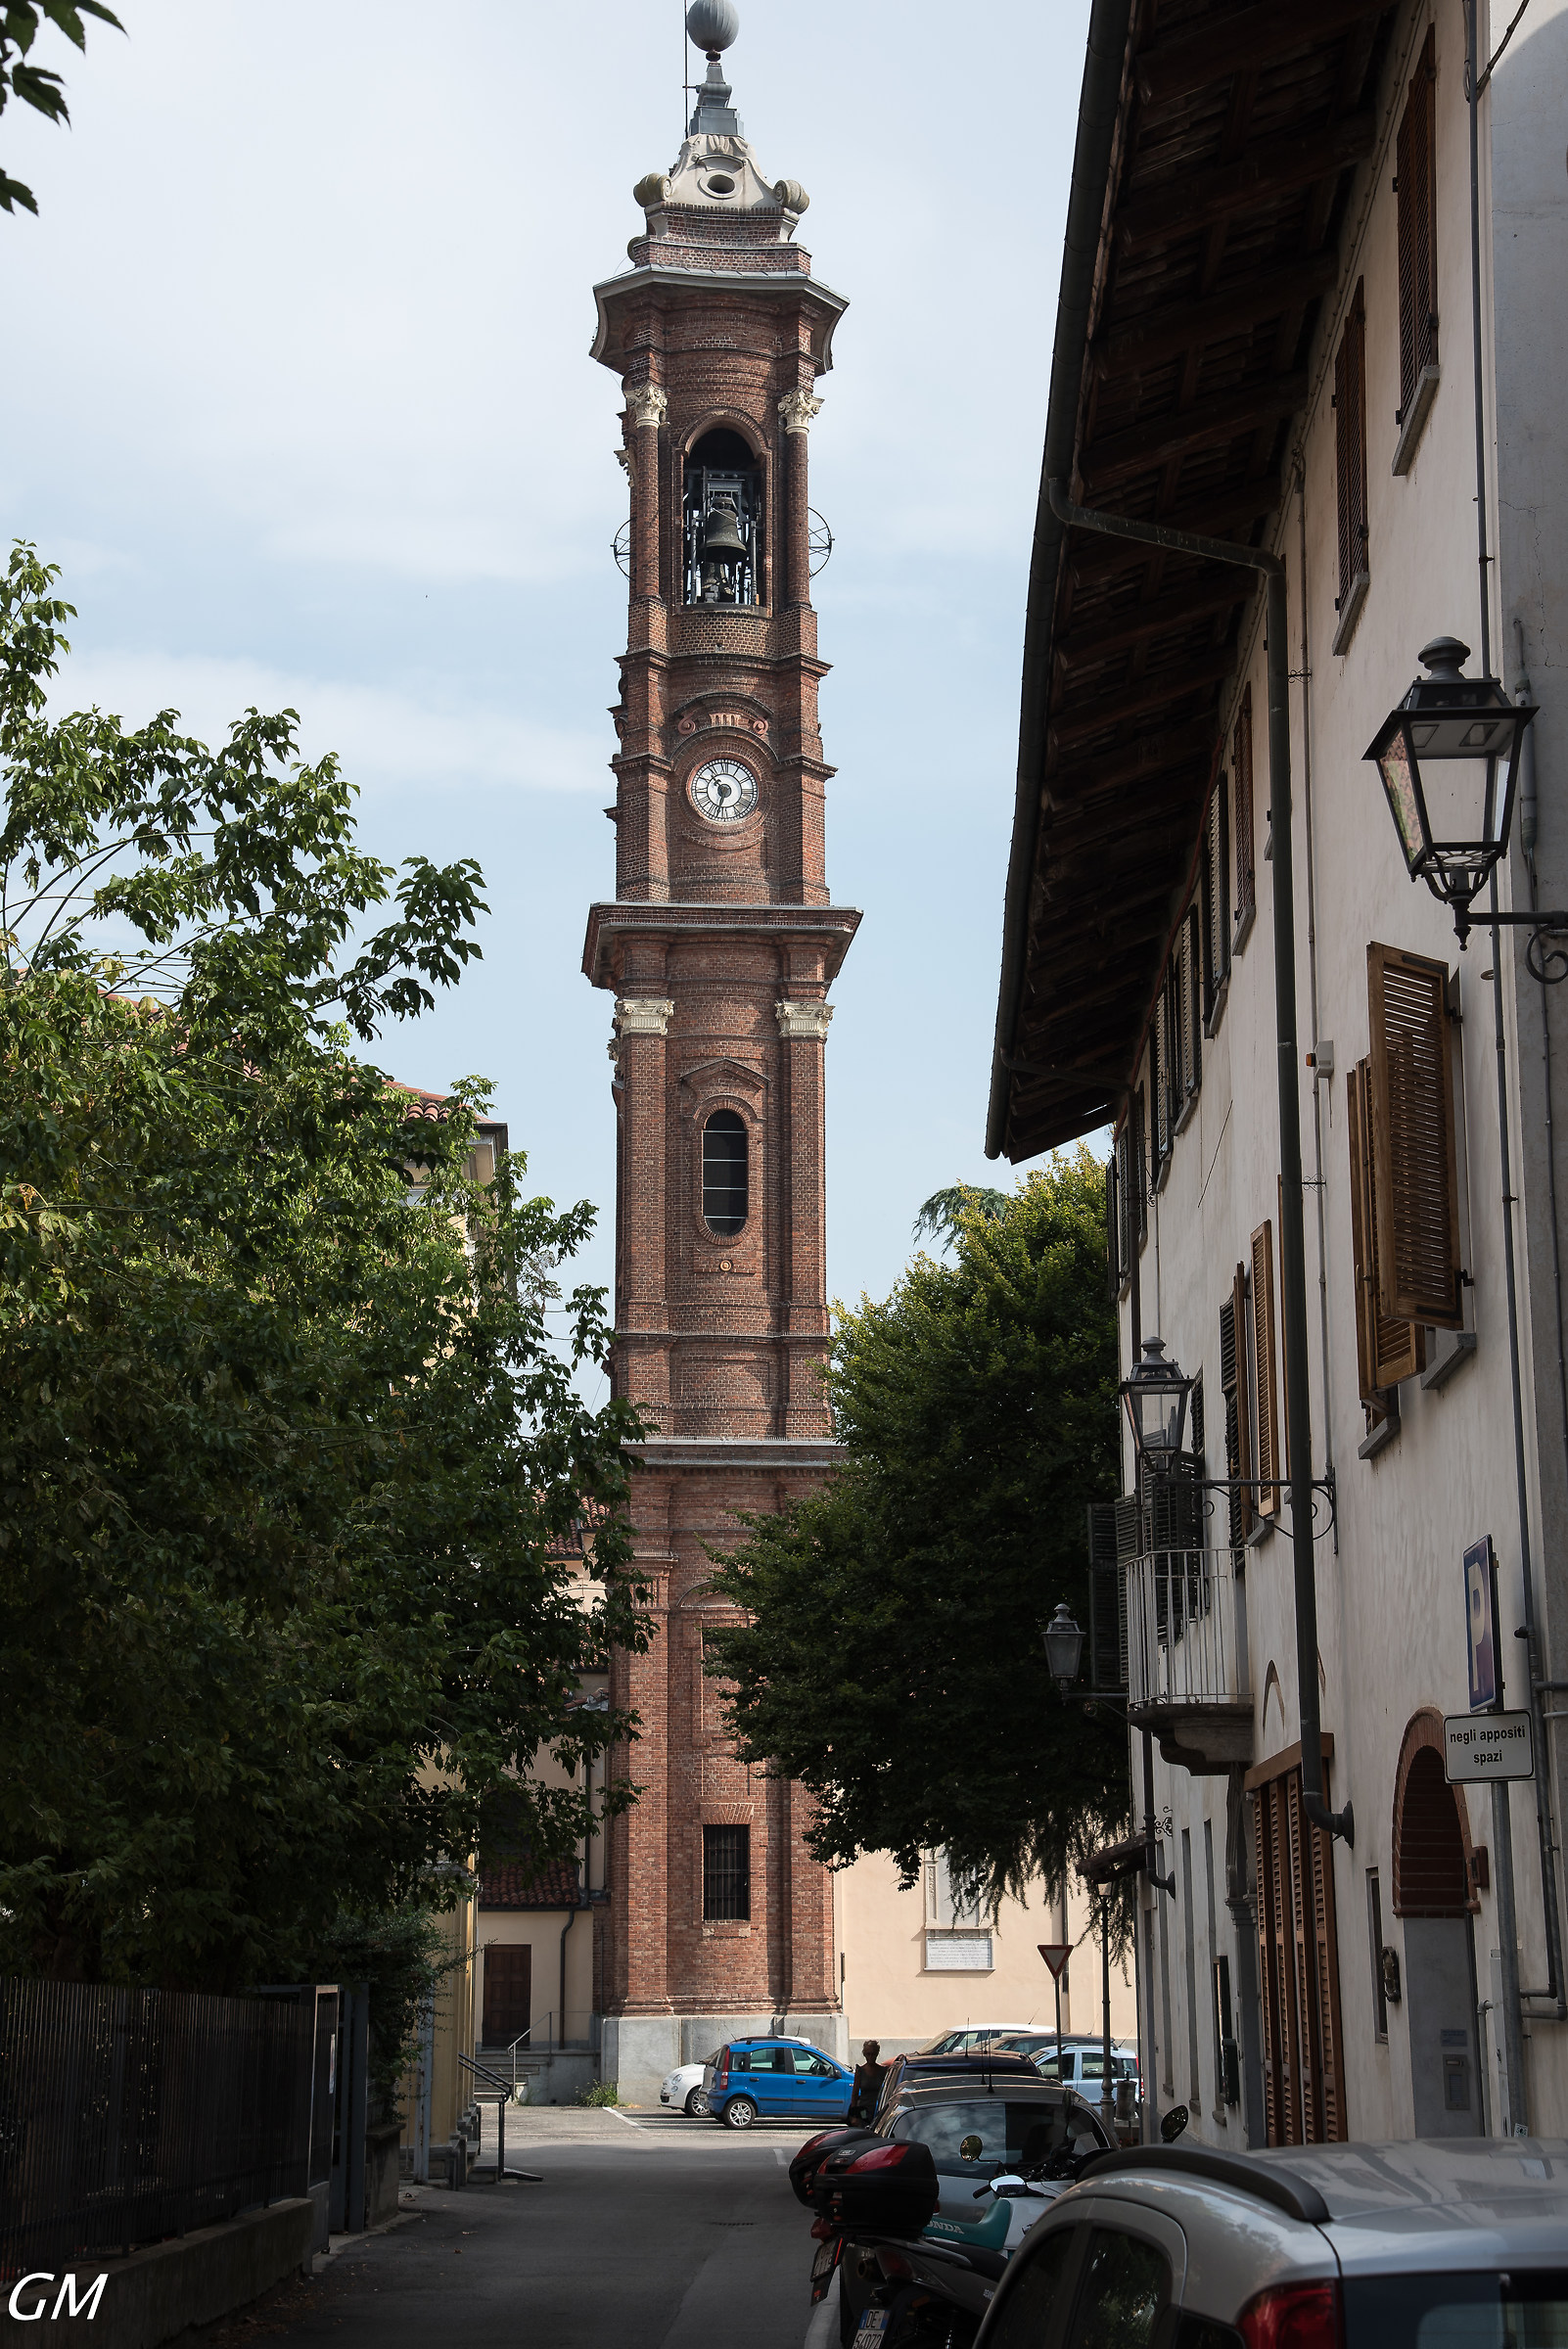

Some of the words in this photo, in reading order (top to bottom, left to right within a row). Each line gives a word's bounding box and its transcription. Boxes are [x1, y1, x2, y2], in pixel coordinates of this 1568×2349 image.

[1468, 1562, 1485, 1691] P
[1450, 1729, 1476, 1745] negli
[1480, 1726, 1526, 1742] appositi
[1473, 1750, 1502, 1766] spazi
[865, 2311, 880, 2328] DE
